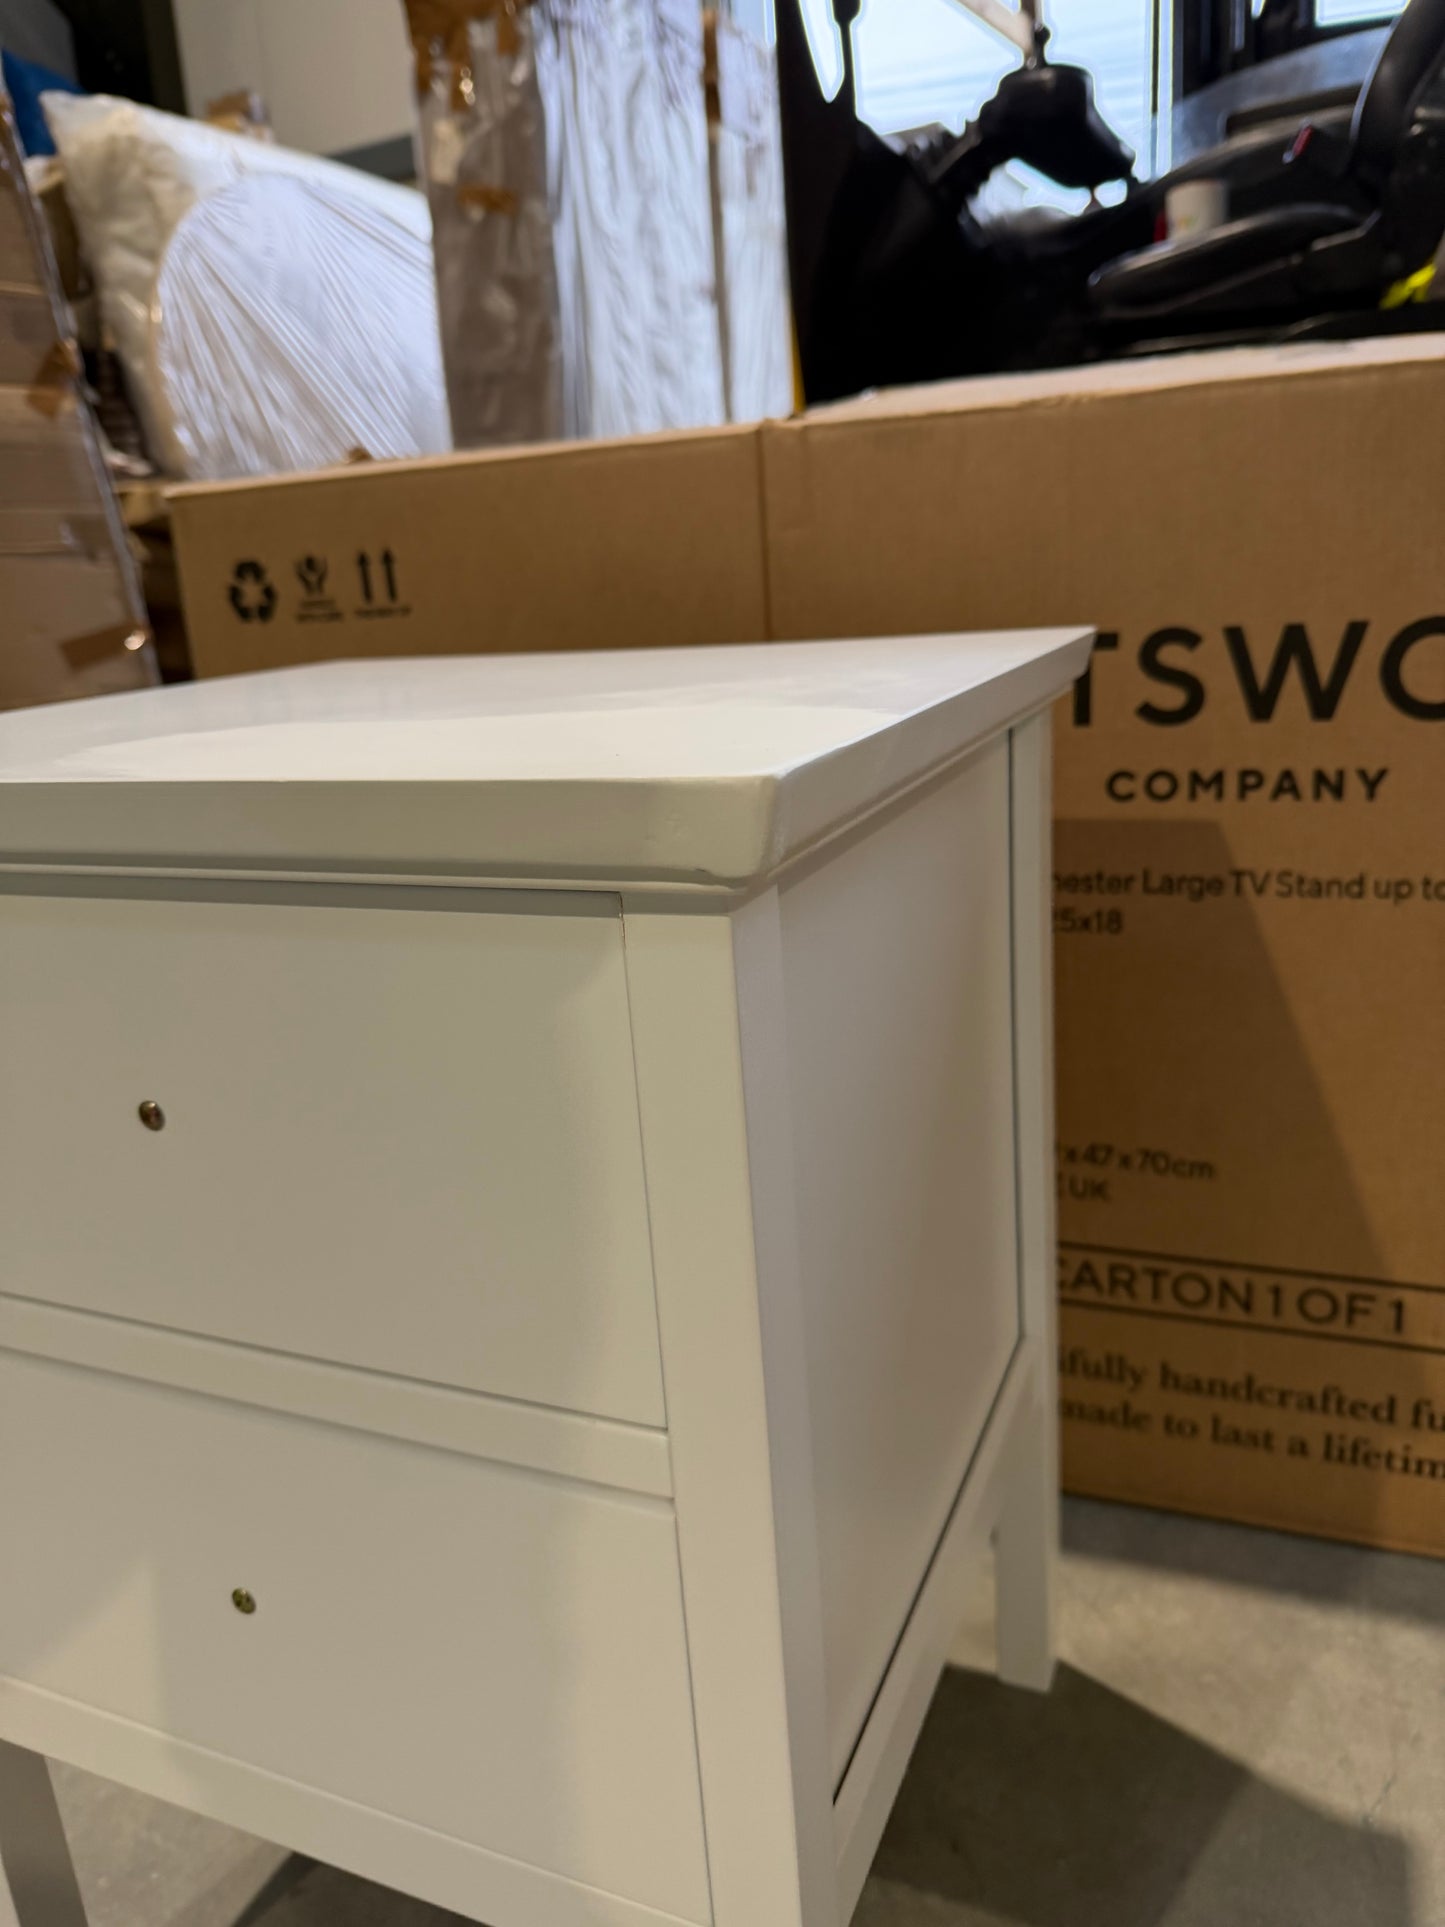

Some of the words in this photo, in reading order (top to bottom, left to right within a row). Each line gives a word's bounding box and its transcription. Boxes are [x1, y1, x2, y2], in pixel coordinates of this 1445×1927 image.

[1106, 767, 1389, 803] COMPANY
[1142, 868, 1224, 902] Large
[1229, 867, 1271, 897] TV
[1275, 868, 1366, 899] Stand
[1374, 877, 1414, 906] up
[1053, 907, 1125, 935] 5x18
[1068, 1175, 1111, 1202] UK
[1059, 1255, 1254, 1315] ARTON
[1268, 1283, 1284, 1319] 1
[1296, 1287, 1376, 1328] OF
[1391, 1300, 1406, 1335] 1
[1159, 1359, 1398, 1426] handcrafted
[1163, 1413, 1199, 1439] to
[1210, 1412, 1275, 1456] last
[1287, 1434, 1310, 1459] a
